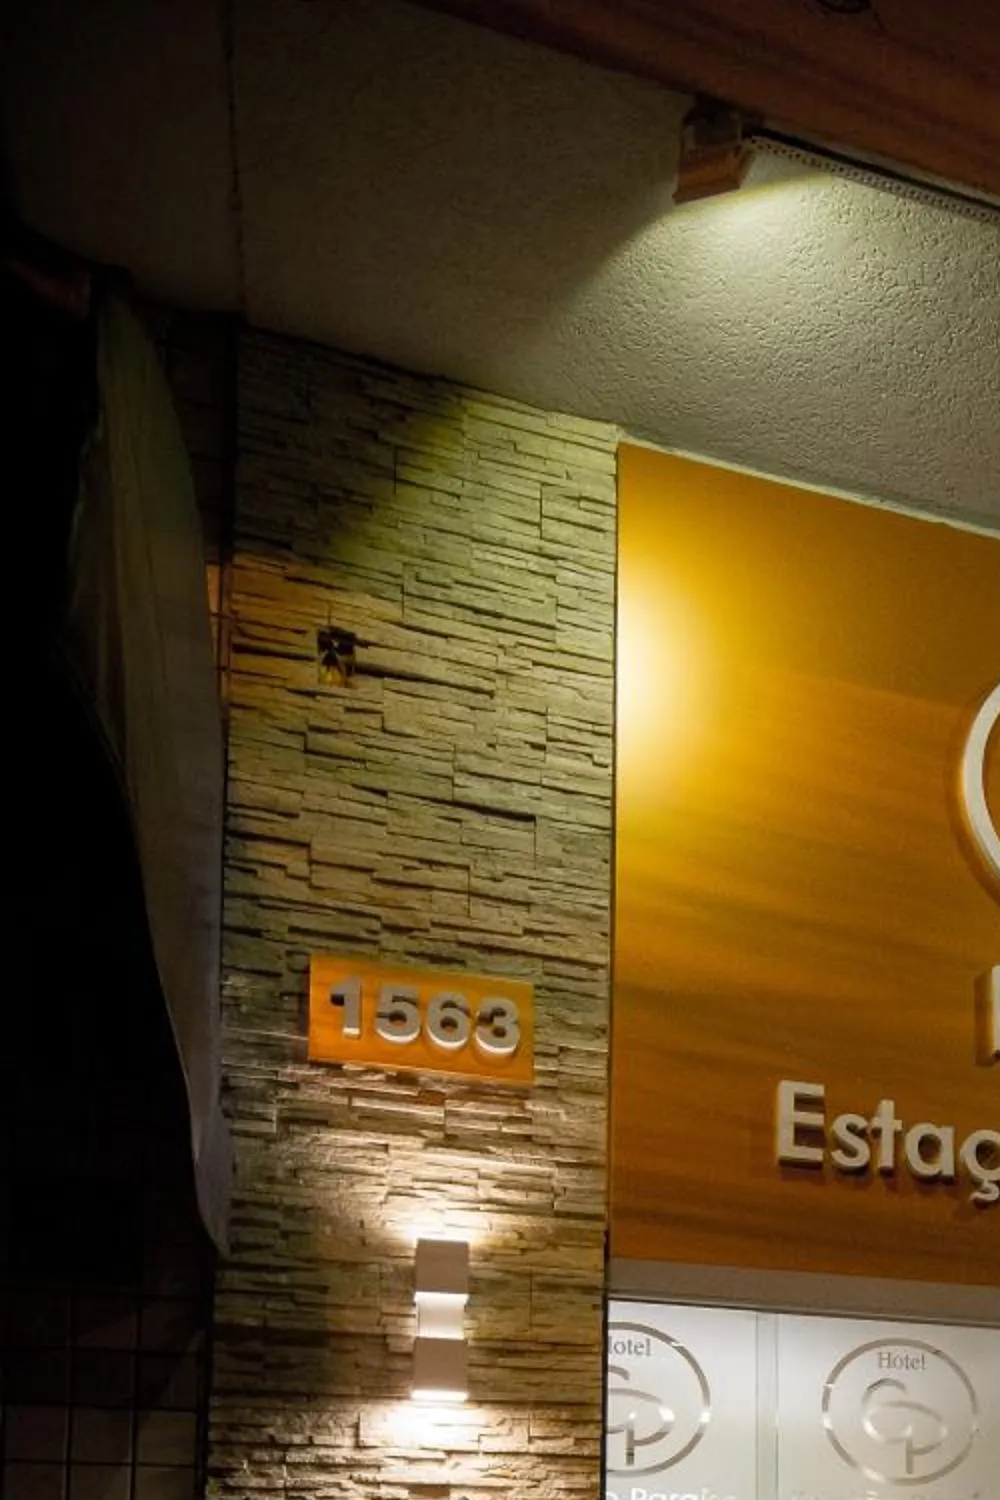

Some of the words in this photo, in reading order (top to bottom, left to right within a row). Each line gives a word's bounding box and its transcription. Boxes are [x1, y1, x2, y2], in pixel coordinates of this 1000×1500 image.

[329, 974, 521, 1056] 1563
[608, 1335, 652, 1356] otel
[877, 1351, 926, 1371] Hotel
